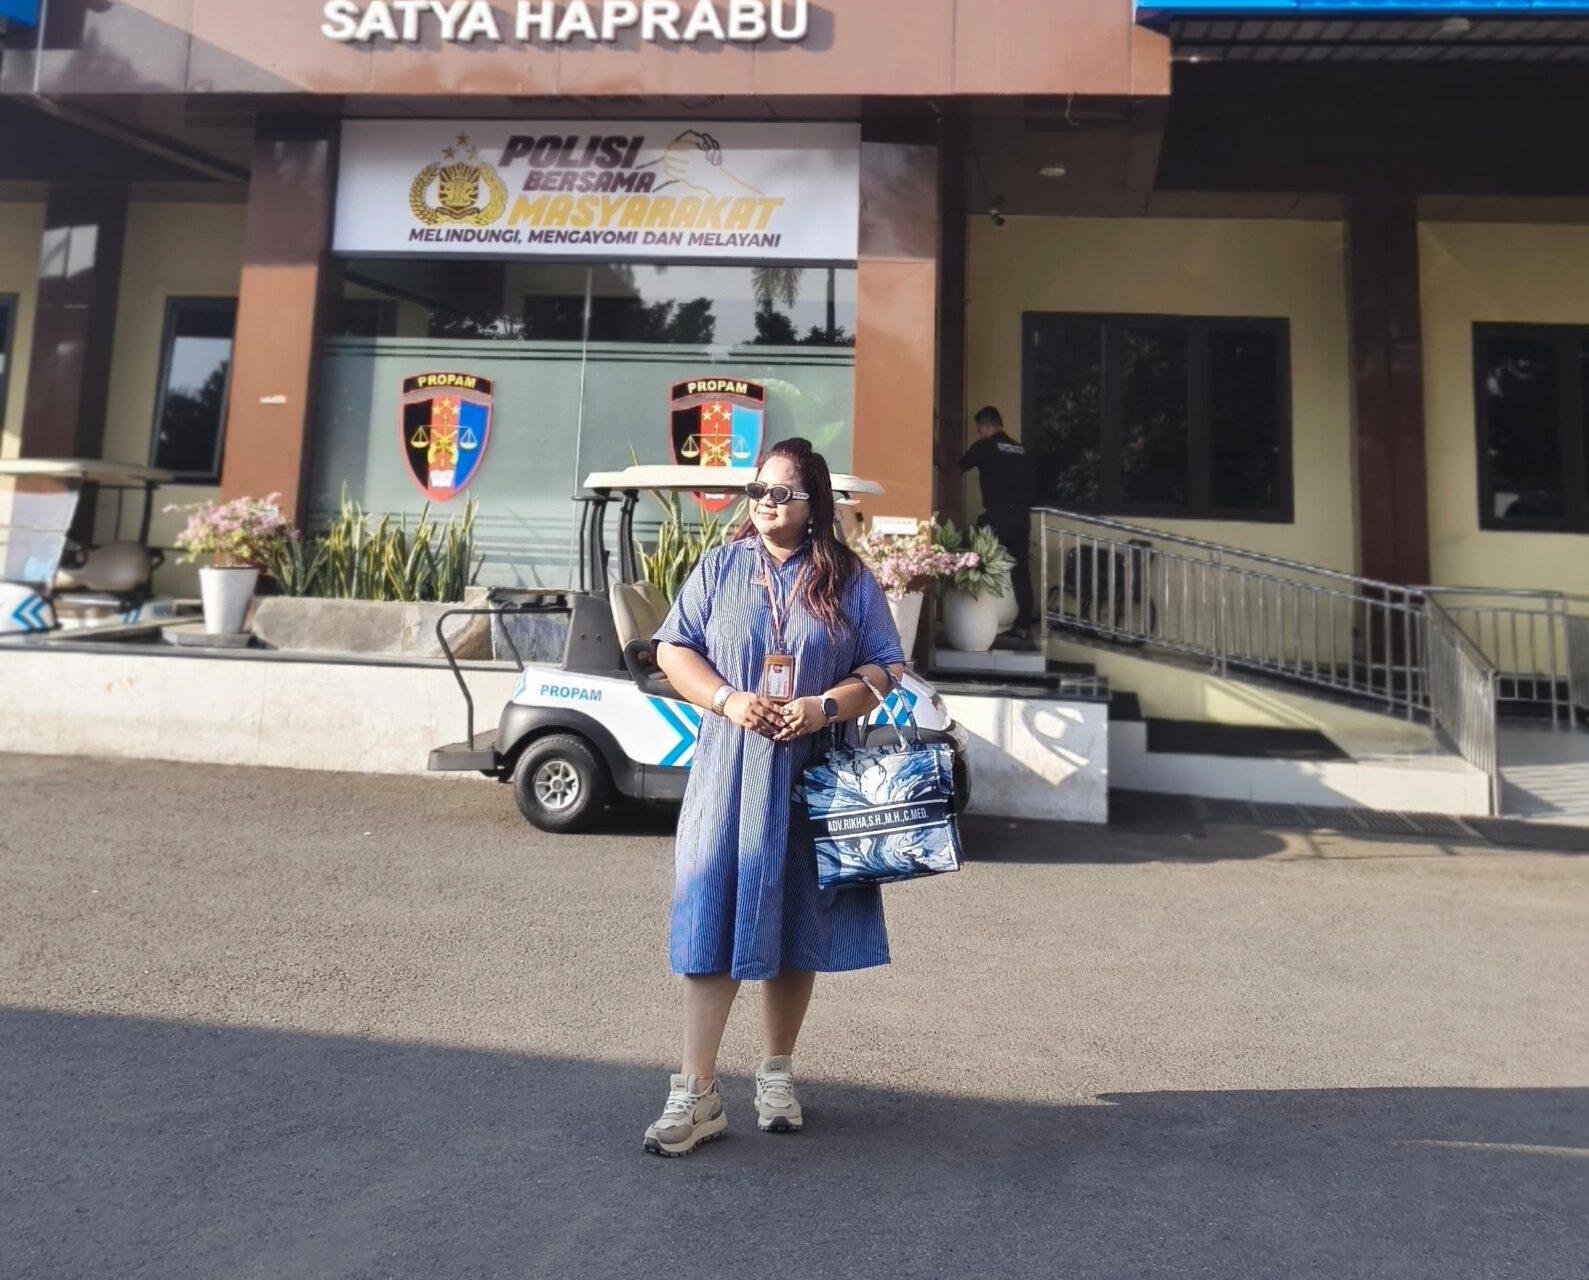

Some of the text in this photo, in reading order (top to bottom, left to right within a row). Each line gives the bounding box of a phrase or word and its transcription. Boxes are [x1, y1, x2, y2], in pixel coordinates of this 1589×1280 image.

[498, 134, 645, 169] POLISI
[522, 170, 656, 193] BERSAMA
[506, 194, 784, 230] MASYARAKAT
[408, 227, 782, 248] MELINDUNGI, MENGAYOMI DAN MELAYANI
[418, 374, 476, 388] PROPAM
[687, 380, 748, 394] PROPAM
[540, 684, 602, 701] PROPAM
